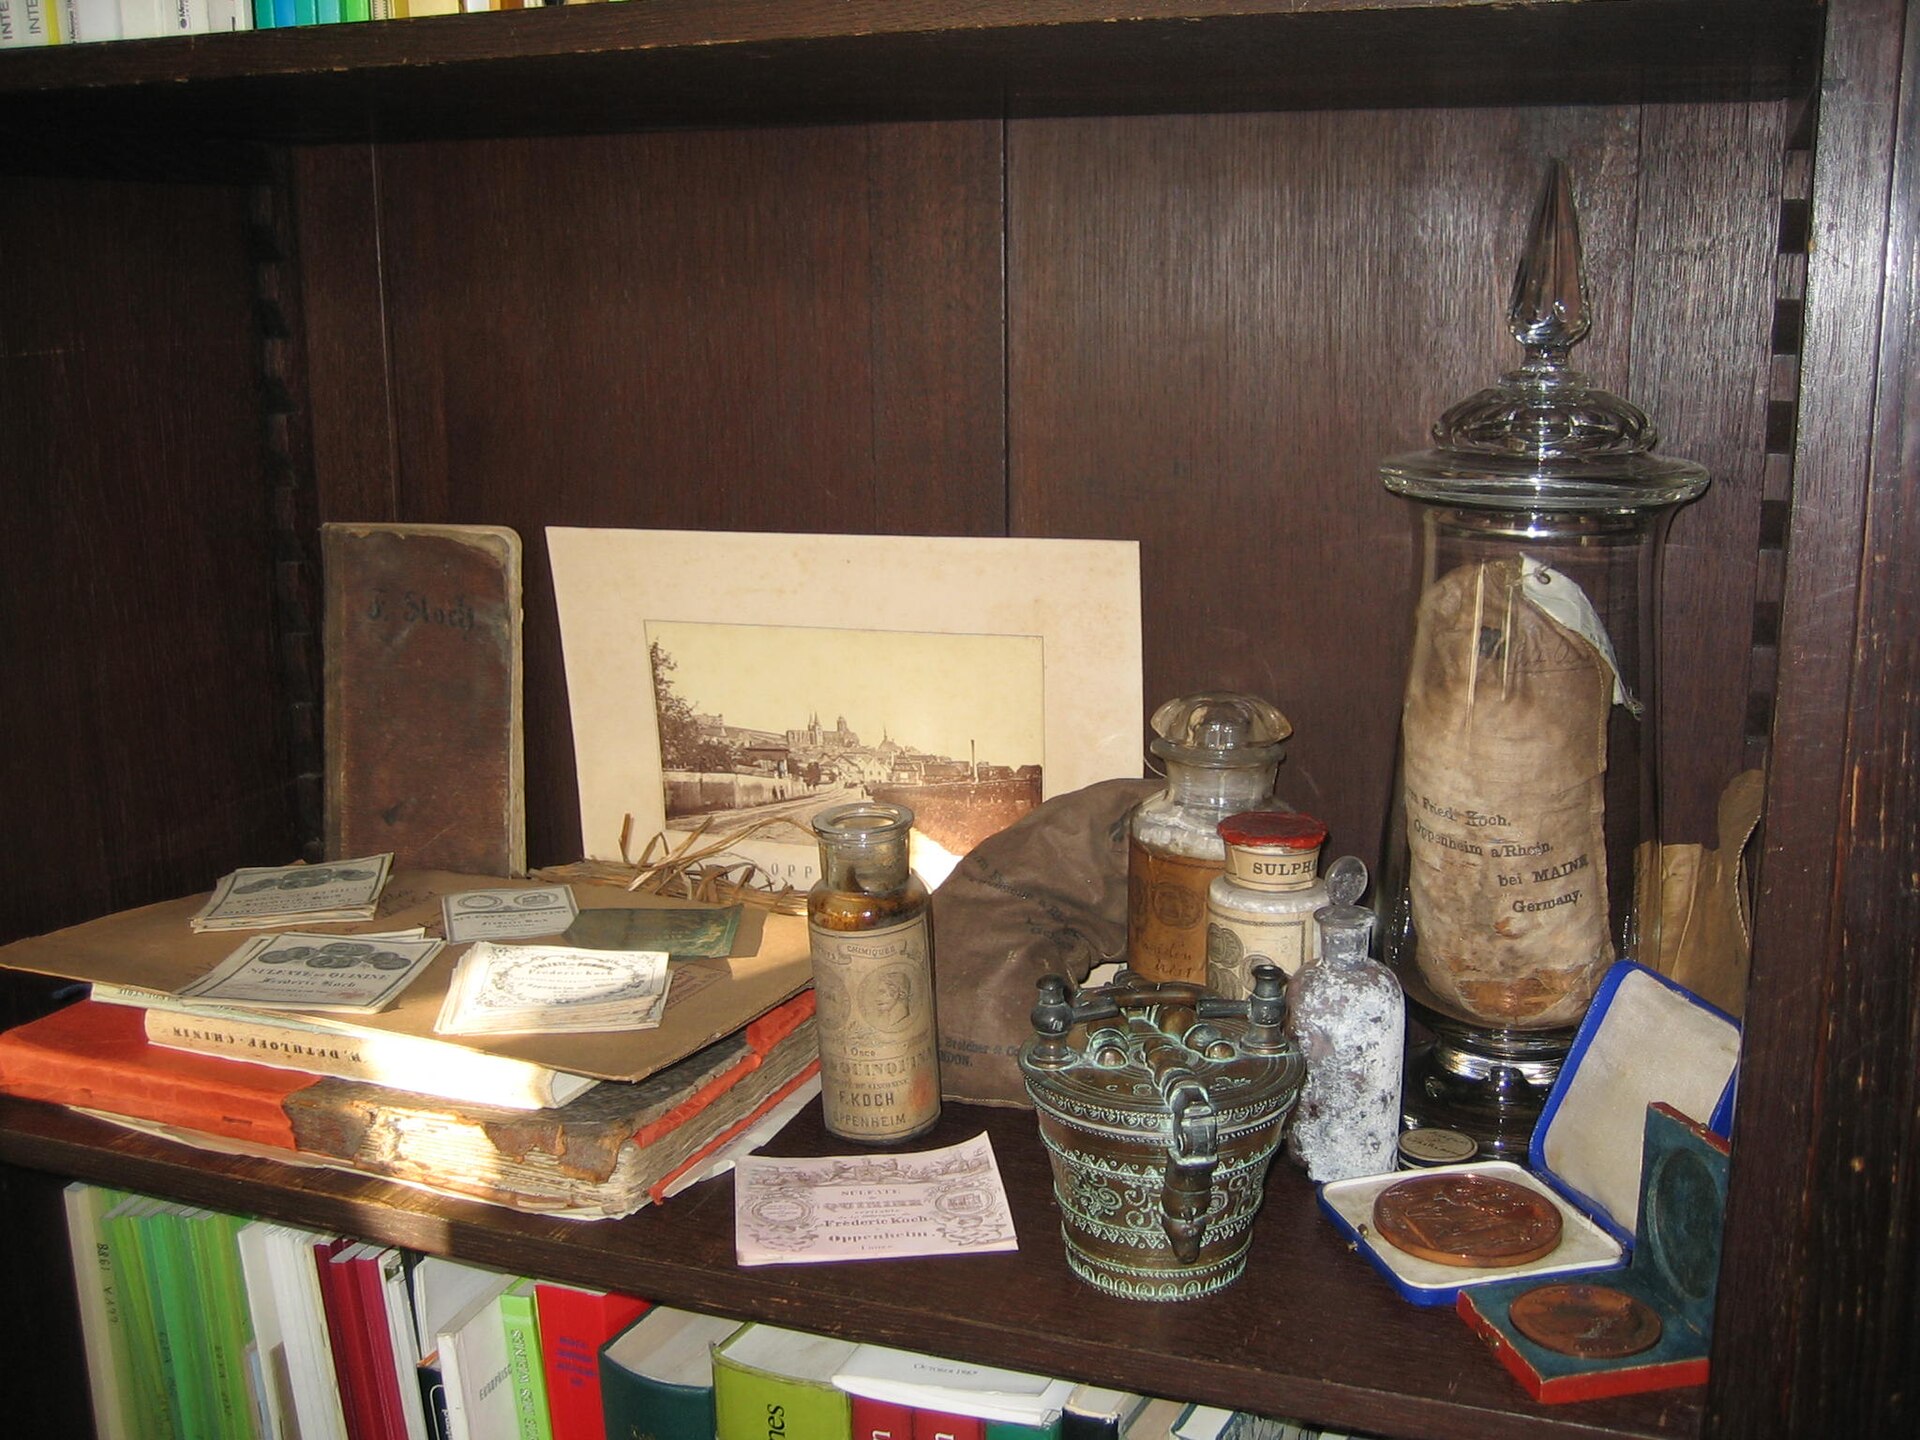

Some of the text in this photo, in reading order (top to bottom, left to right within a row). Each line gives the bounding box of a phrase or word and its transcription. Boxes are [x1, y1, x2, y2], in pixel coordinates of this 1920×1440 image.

[1414, 820, 1484, 856] Oppenheim
[1498, 875, 1523, 887] bei
[1512, 889, 1583, 913] Germany.
